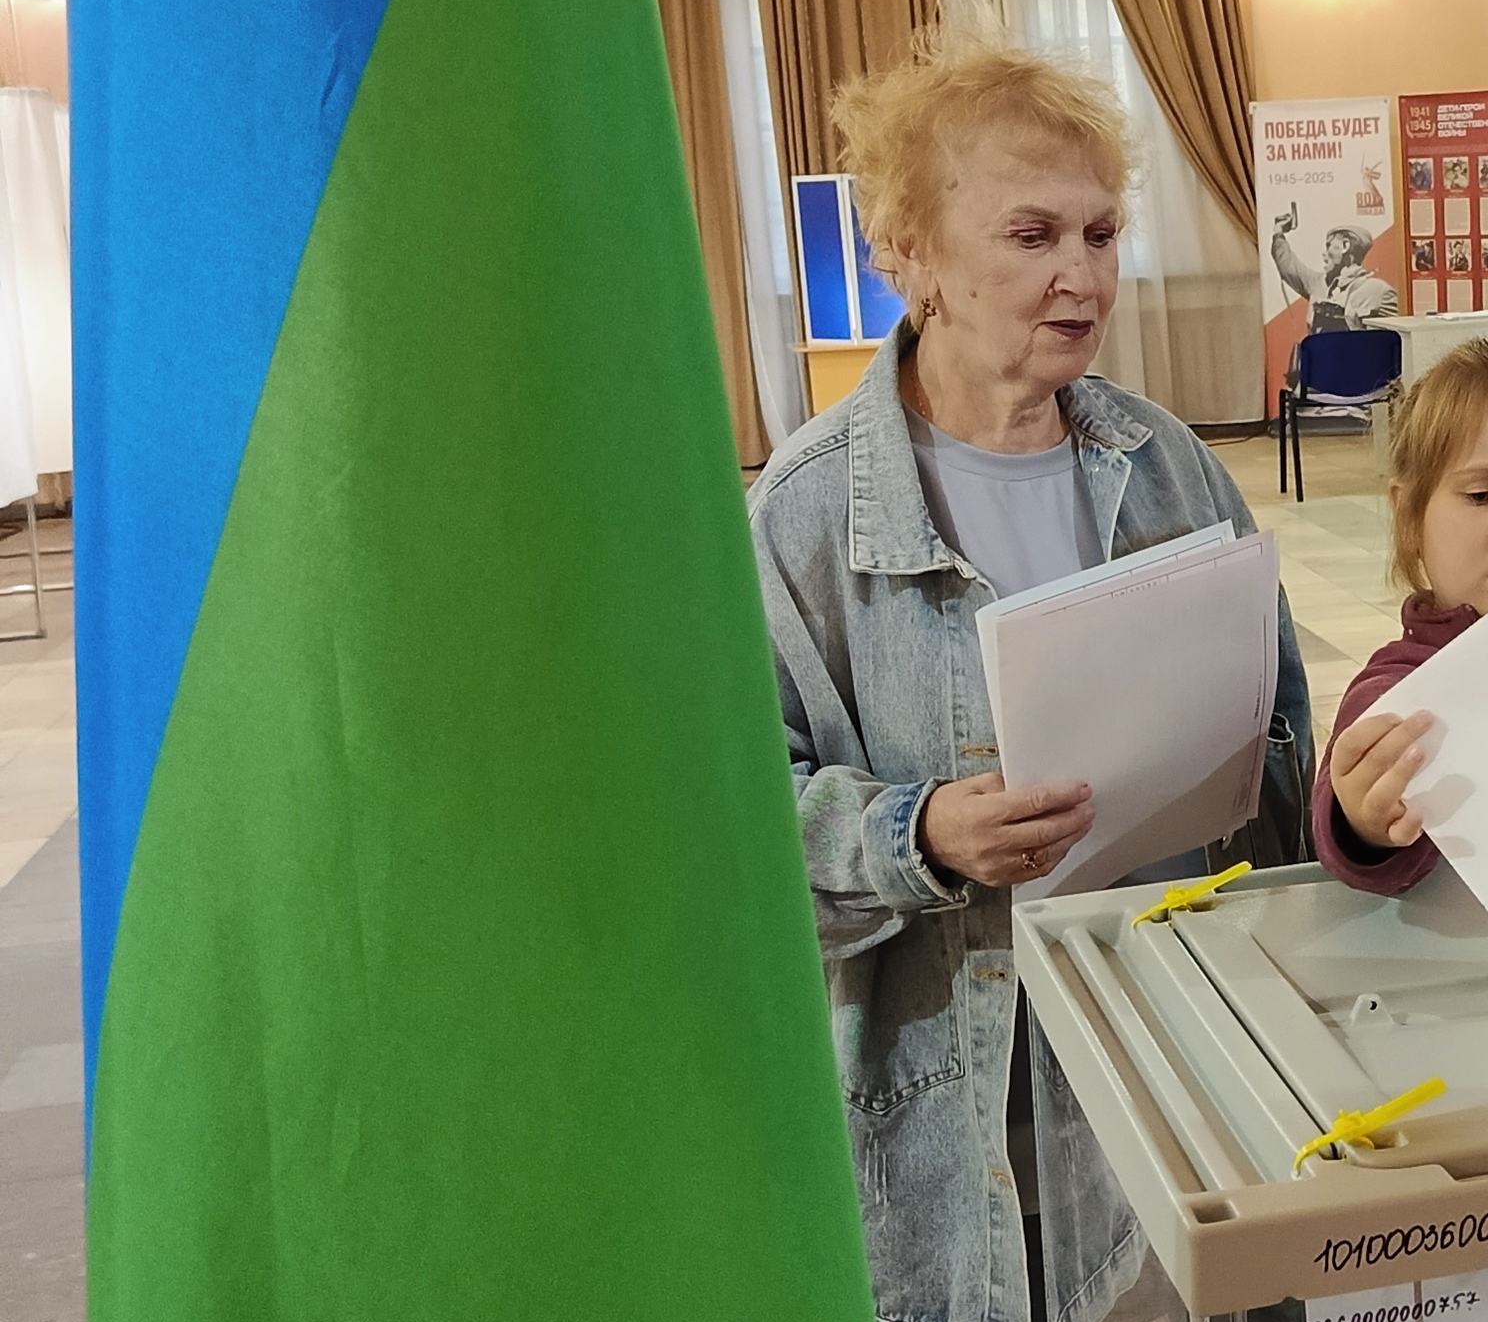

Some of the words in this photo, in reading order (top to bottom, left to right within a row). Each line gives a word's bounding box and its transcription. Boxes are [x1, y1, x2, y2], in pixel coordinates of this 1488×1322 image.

[1410, 106, 1430, 117] 1941
[1264, 120, 1327, 140] ПОБЕДА
[1332, 117, 1380, 138] БУДЕТ
[1410, 120, 1431, 131] 1945
[1266, 144, 1287, 161] ЗА
[1291, 142, 1342, 160] НАМИ!
